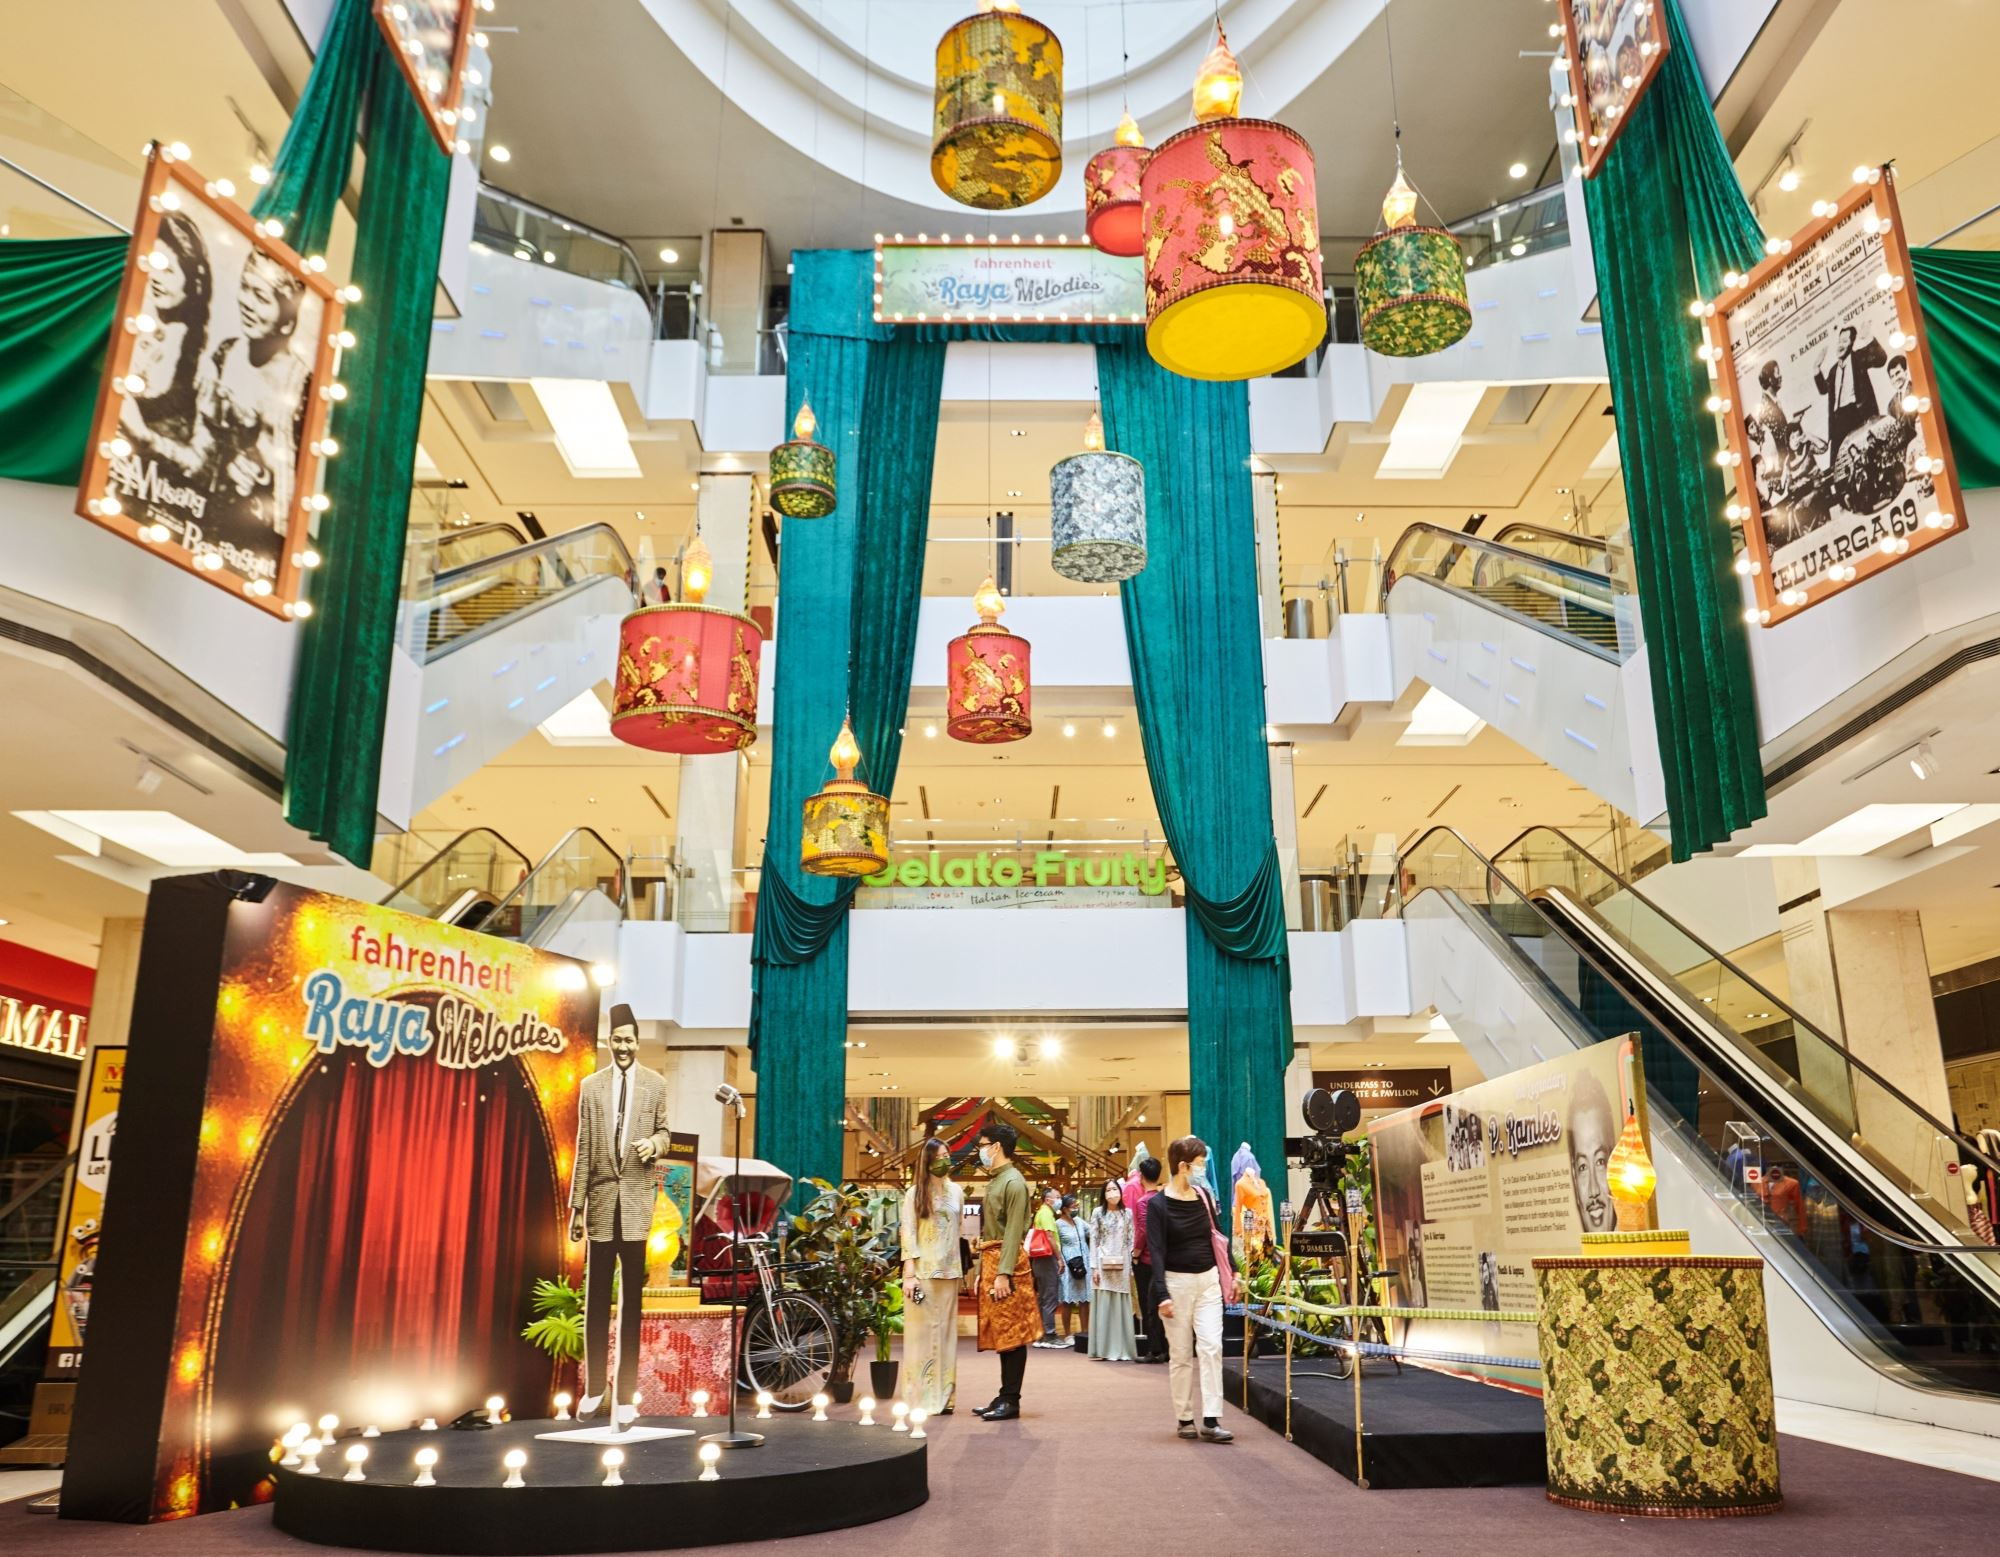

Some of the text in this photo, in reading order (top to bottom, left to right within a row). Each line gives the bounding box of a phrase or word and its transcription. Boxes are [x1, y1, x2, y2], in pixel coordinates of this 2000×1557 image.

[973, 257, 1053, 269] fahrenheit
[1831, 245, 1862, 272] GRAND
[937, 276, 1101, 305] Raya Melodies
[1803, 276, 1821, 295] REX
[1843, 302, 1864, 324] SIPUT
[1730, 340, 1742, 353] EX
[1799, 330, 1828, 356] RAMLEE
[1890, 498, 1919, 540] 69
[1033, 851, 1166, 896] Fruity
[351, 925, 513, 994] fahrenheit
[0, 994, 87, 1061] MAL
[305, 969, 564, 1069] Raya Melodies
[1330, 1080, 1394, 1090] UNDERPASS TO
[1381, 1088, 1419, 1098] PAVILION
[1488, 1103, 1561, 1156] P. Ramlee
